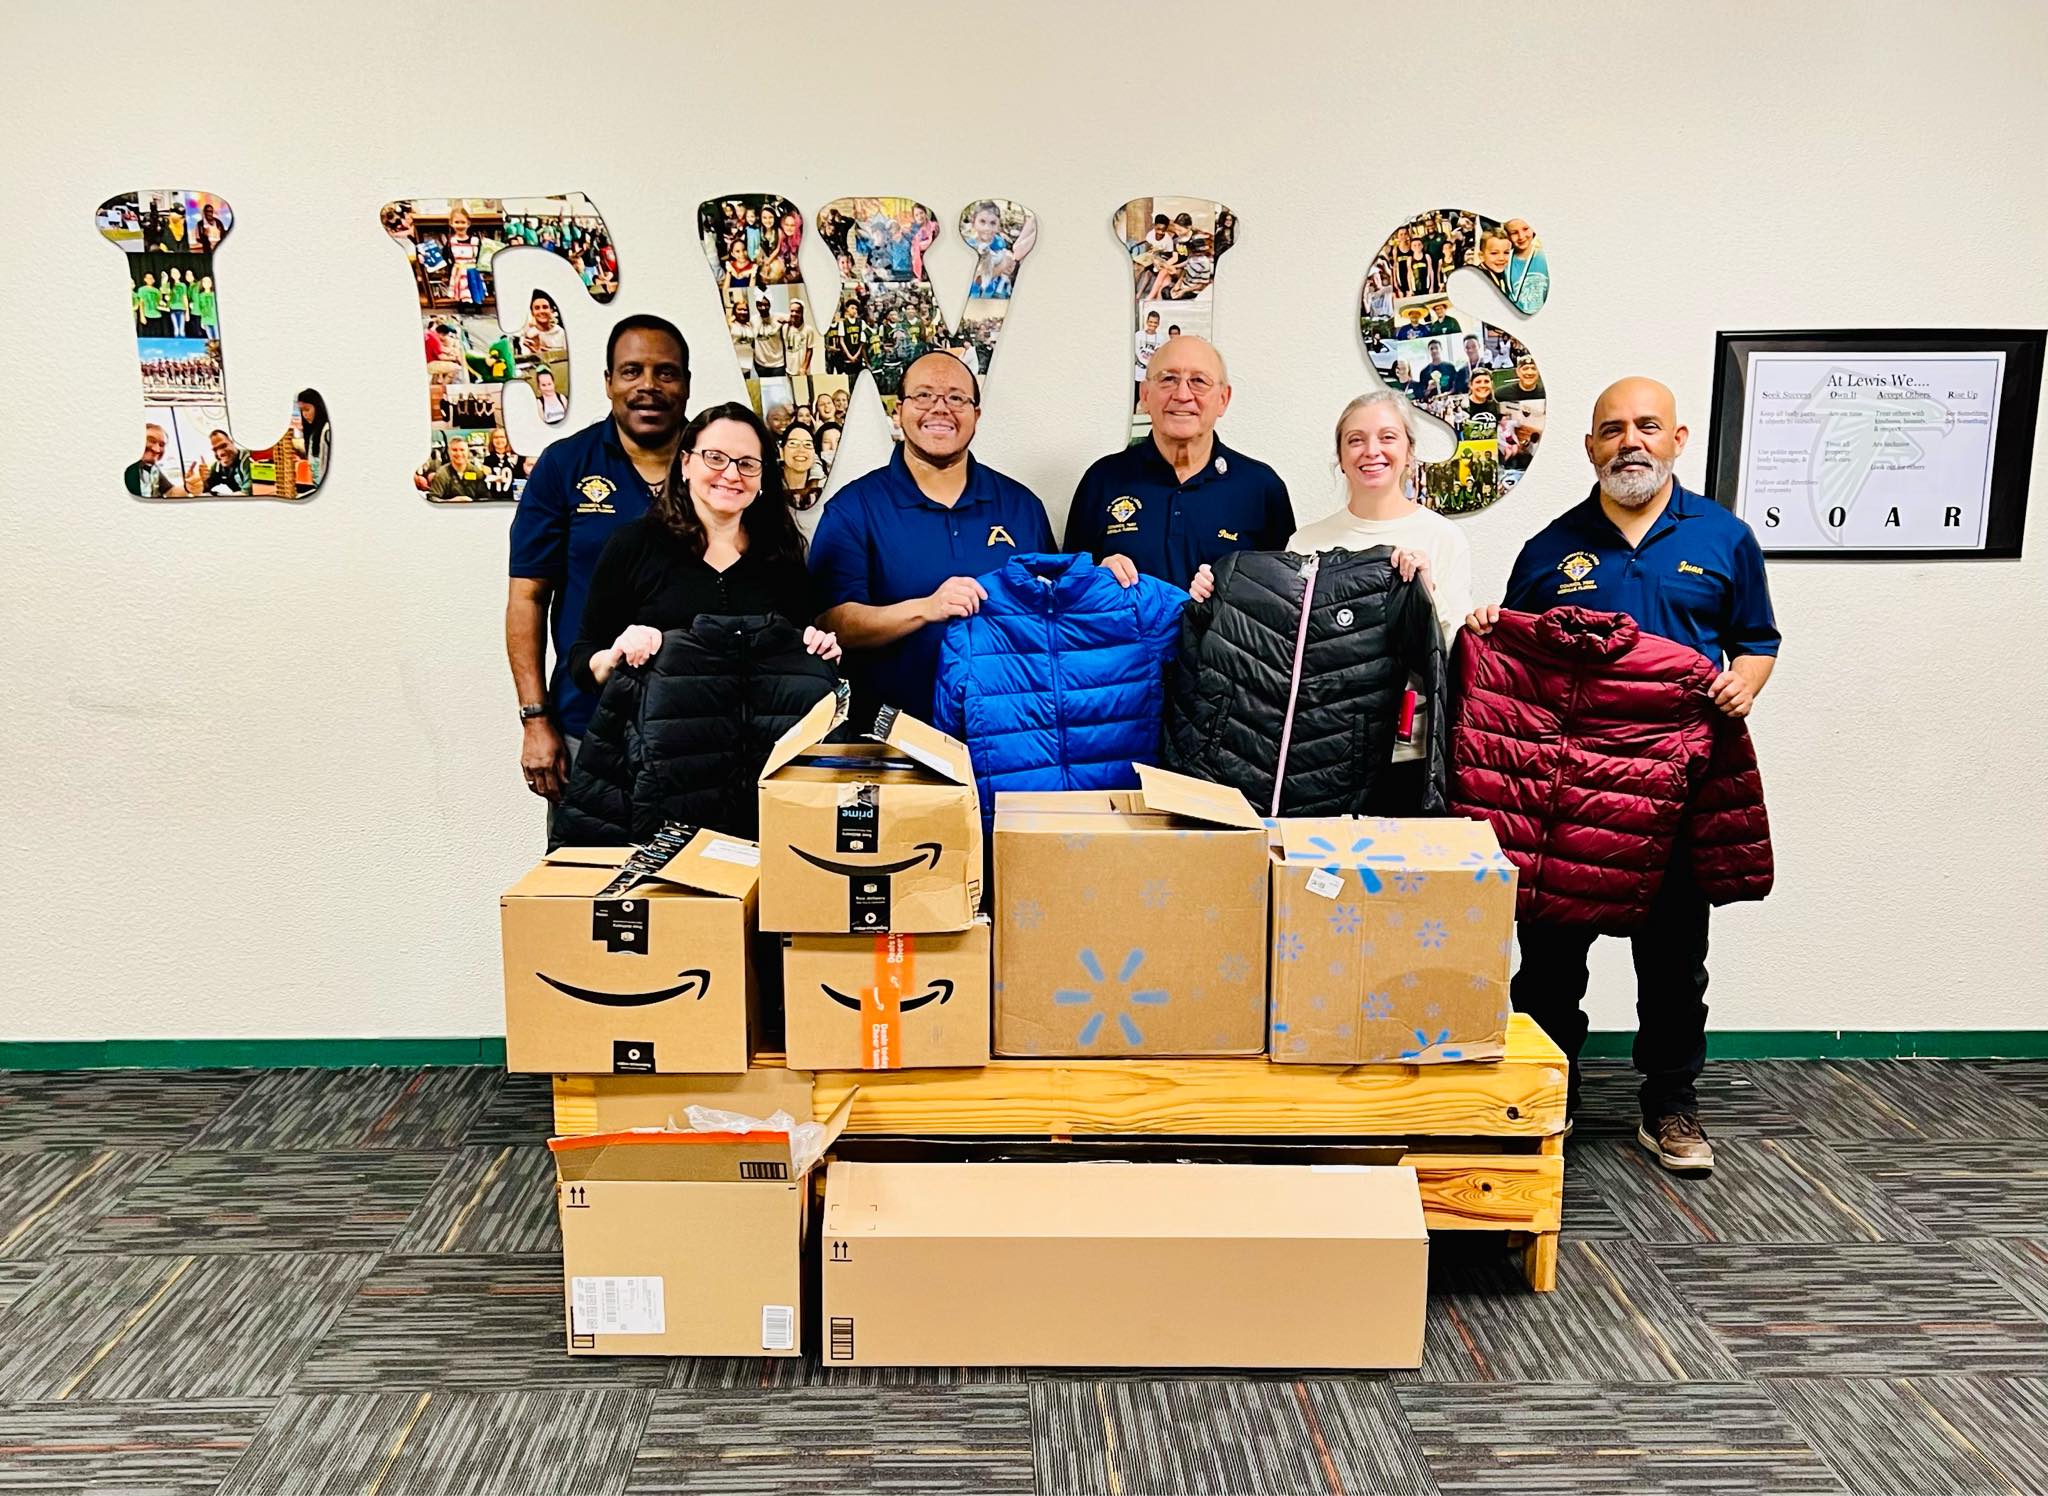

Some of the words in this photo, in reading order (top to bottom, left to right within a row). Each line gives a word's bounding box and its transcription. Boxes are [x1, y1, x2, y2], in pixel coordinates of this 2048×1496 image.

[1827, 374, 1842, 387] At
[1848, 374, 1887, 387] Lewis
[1877, 391, 1904, 400] Accept
[1905, 390, 1931, 399] Others
[842, 809, 874, 821] prime
